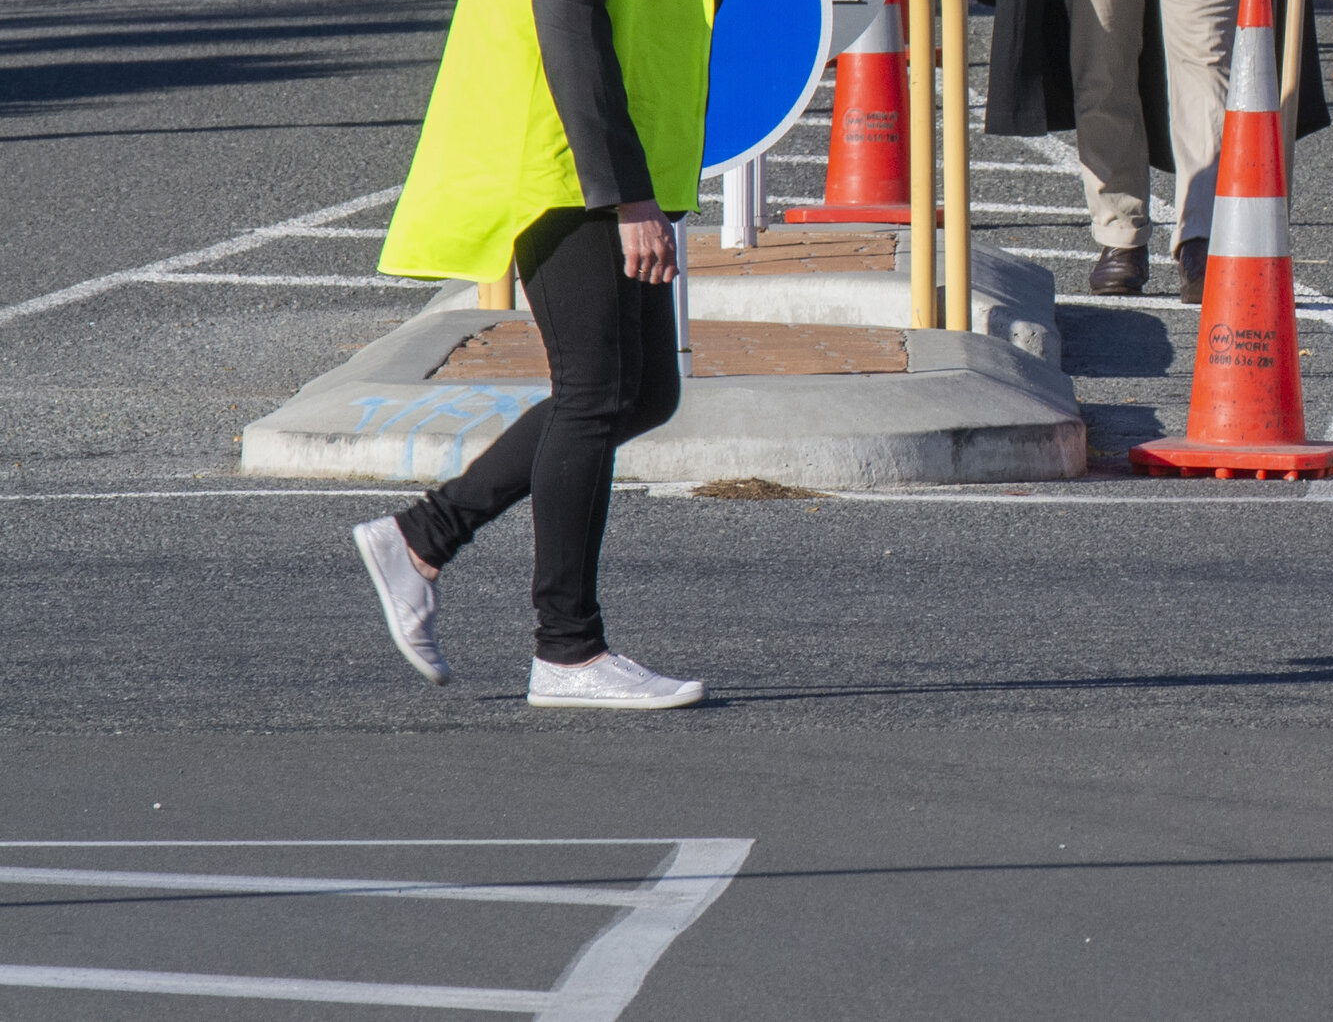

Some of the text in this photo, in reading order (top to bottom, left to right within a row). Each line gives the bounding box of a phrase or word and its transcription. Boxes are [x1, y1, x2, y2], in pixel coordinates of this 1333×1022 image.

[1235, 330, 1262, 339] MEN
[1263, 331, 1277, 340] AT
[1235, 341, 1269, 352] WORK
[1209, 354, 1231, 365] 0800
[1235, 354, 1253, 366] 636
